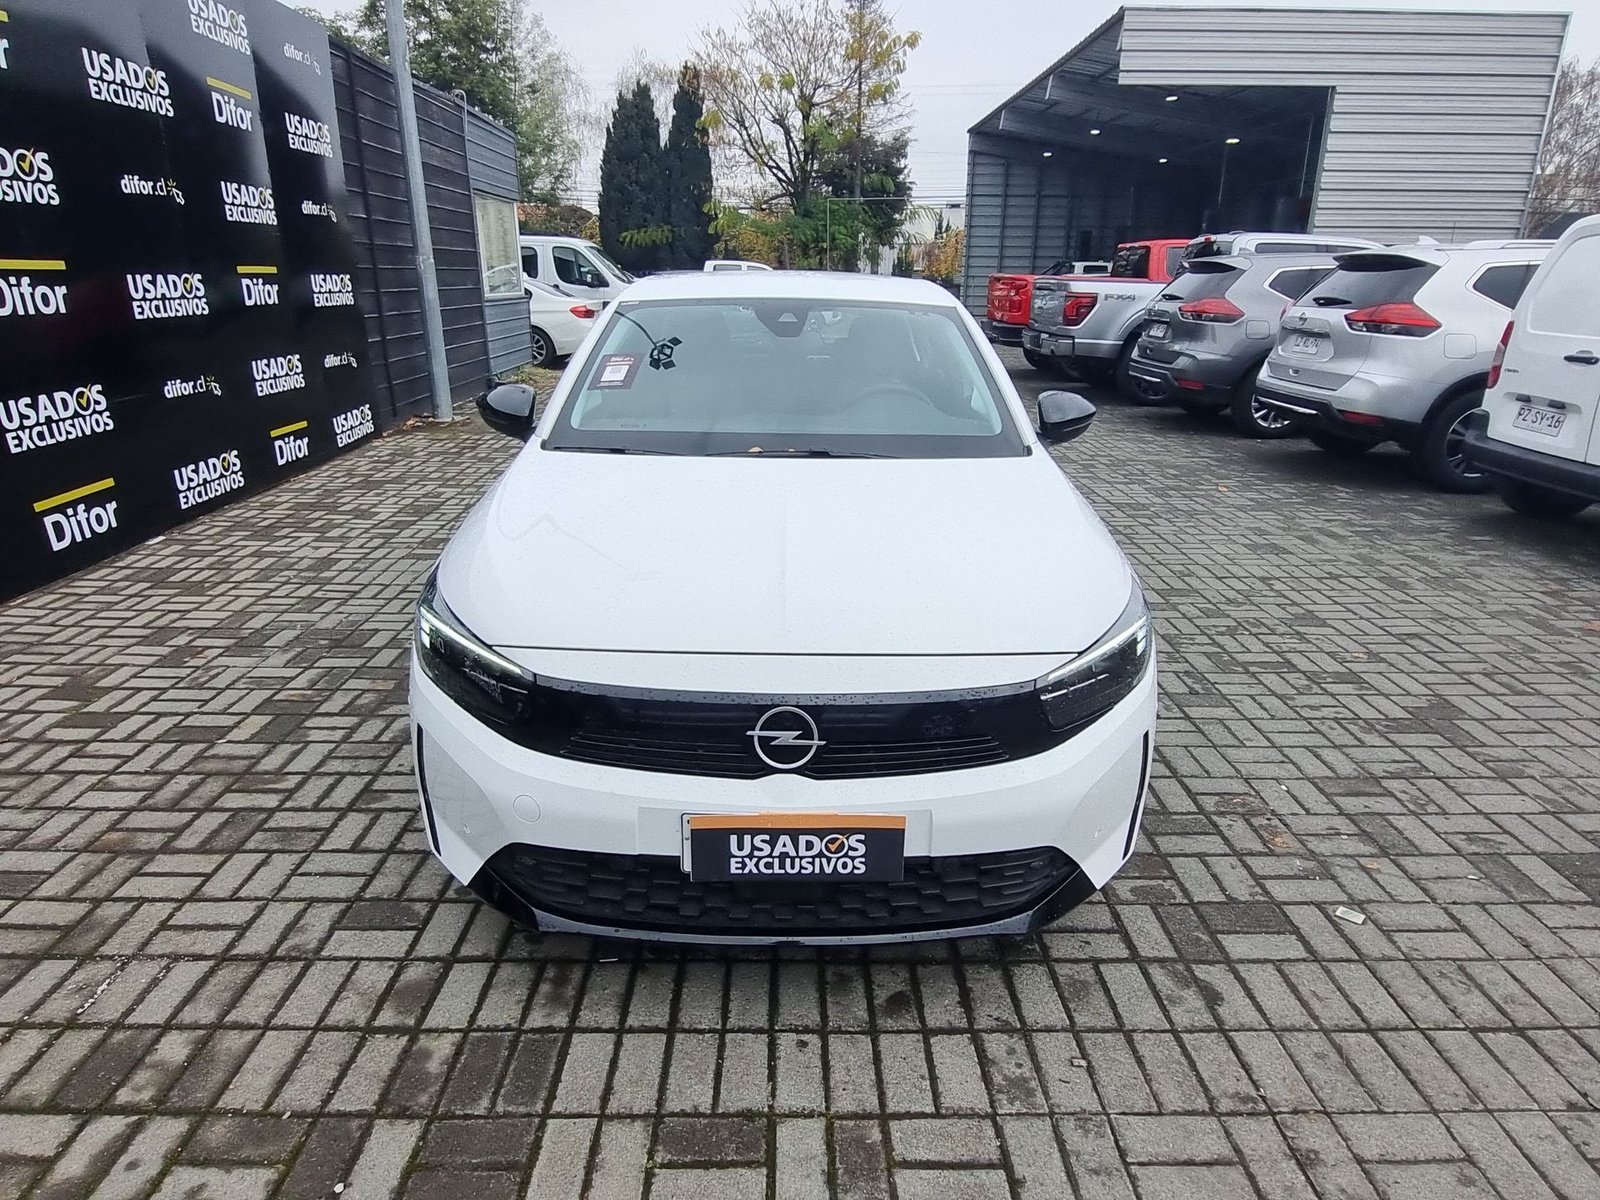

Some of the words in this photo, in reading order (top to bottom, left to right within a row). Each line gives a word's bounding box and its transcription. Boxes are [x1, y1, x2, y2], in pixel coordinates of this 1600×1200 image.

[187, 0, 247, 36] USADOS
[190, 14, 250, 55] EXCLUSIVOS
[284, 43, 310, 65] difor.cl
[81, 47, 170, 97] USADOS
[88, 77, 174, 117] EXCLUSIVOS
[211, 91, 252, 131] Difor
[285, 112, 330, 142] USADOS
[288, 134, 332, 157] EXCLUSIVOS
[120, 174, 167, 196] difor.cl
[221, 181, 274, 209] USADOS
[225, 206, 277, 225] EXCLUSIVOS
[301, 200, 328, 216] difor.cl
[126, 274, 205, 300] USADOS
[241, 278, 279, 307] Difor
[310, 274, 352, 294] USADOS
[1104, 293, 1136, 301] FX4
[132, 298, 209, 320] EXCLUSIVOS
[314, 293, 355, 308] EXCLUSIVOS
[252, 354, 302, 380] USADOS
[325, 353, 347, 368] difor.cl
[164, 376, 206, 398] difor.cl
[256, 373, 305, 396] EXCLUSIVOS
[0, 384, 107, 431] USADOS
[333, 404, 372, 433] USADOS
[5, 411, 114, 455] EXCLUSIVOS
[337, 421, 374, 447] EXCLUSIVOS
[274, 436, 308, 465] Difor
[174, 450, 241, 490] USADOS
[179, 471, 244, 509] EXCLUSIVOS
[43, 500, 118, 552] Difor
[730, 833, 866, 857] USADOS
[730, 857, 866, 874] EXCLUSIVOS
